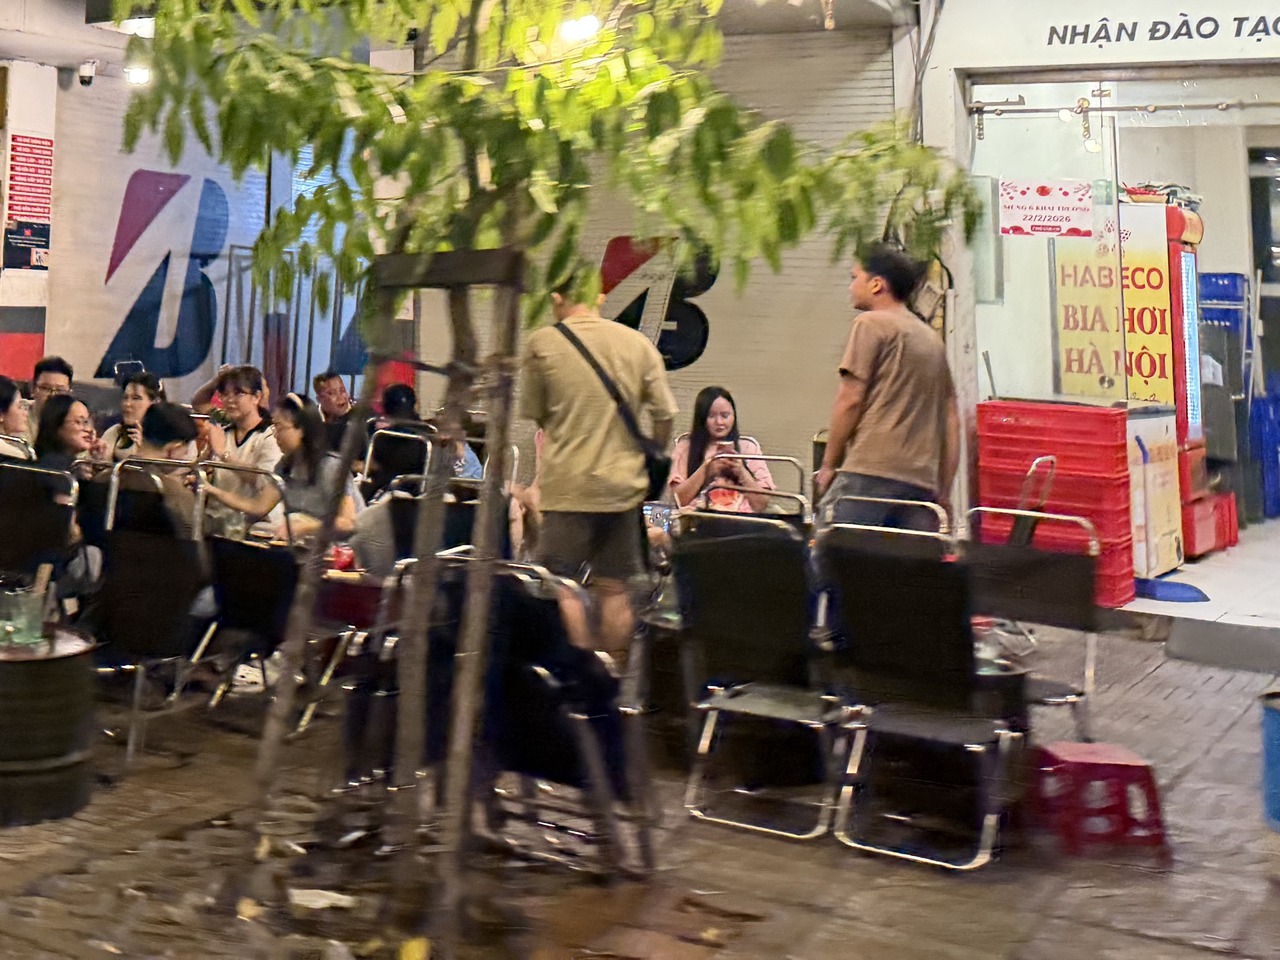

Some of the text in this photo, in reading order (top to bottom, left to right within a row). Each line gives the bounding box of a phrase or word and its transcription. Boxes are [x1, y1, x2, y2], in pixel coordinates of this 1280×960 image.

[1047, 17, 1138, 49] NHẬN
[1148, 13, 1220, 41] ĐÀO
[1022, 214, 1071, 223] 22/2/2026
[1060, 264, 1164, 290] HABECO
[1063, 304, 1169, 336] BIA HƠI
[1065, 342, 1169, 386] HÀ NỘI
